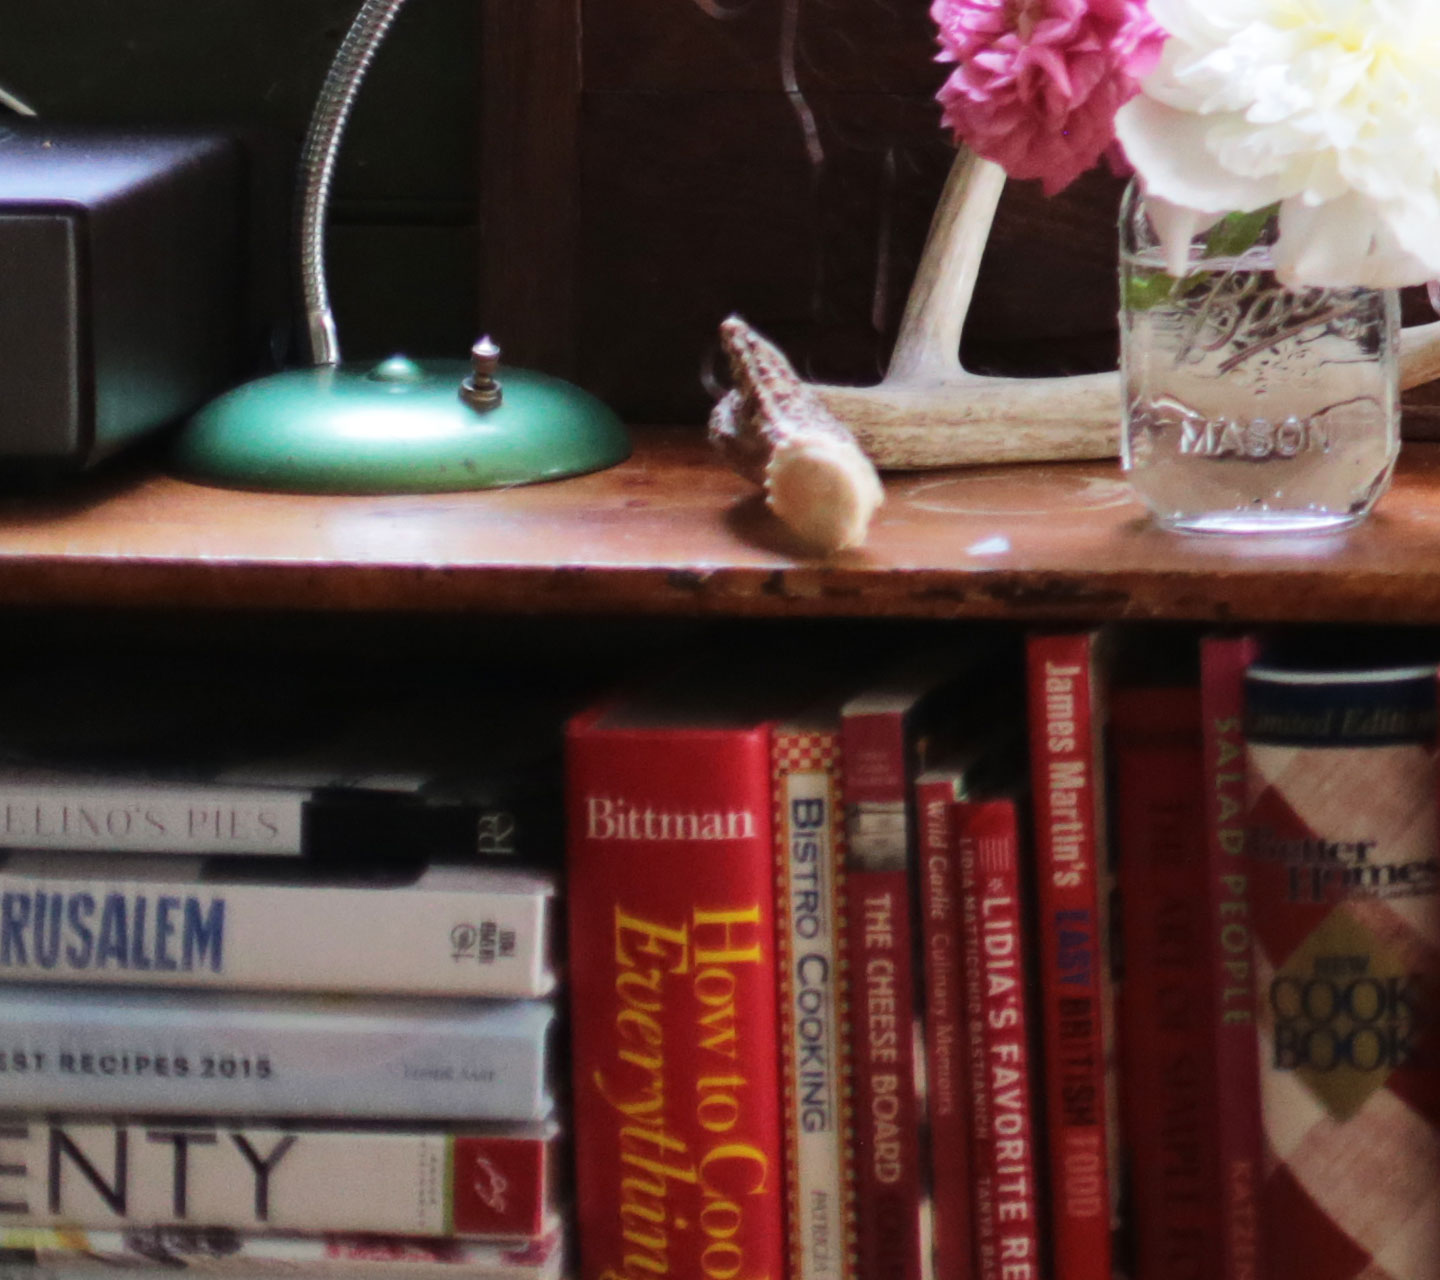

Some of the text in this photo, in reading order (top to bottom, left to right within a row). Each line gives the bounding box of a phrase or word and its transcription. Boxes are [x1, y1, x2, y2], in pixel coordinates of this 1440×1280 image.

[1179, 417, 1332, 457] MASON
[187, 807, 280, 840] PIES
[585, 796, 757, 841] Bittman
[1213, 716, 1253, 1027] SALAD PEOPLE
[791, 798, 830, 1134] BISTRO COOKING
[862, 894, 893, 951] THE
[926, 800, 955, 1115] Wild Garlic Culinary Memoirs
[982, 896, 1016, 1029] LIDIA'S
[1045, 661, 1101, 1218] James Martin's EASY BRITISH FOOD
[59, 1054, 189, 1077] RECIPES
[202, 1057, 273, 1079] 2015
[866, 959, 896, 1064] CHEESE
[592, 902, 694, 1280] Everythin
[691, 903, 769, 1280] How to Coo
[871, 1074, 901, 1182] BOARD
[991, 1044, 1028, 1220] FAVORITE
